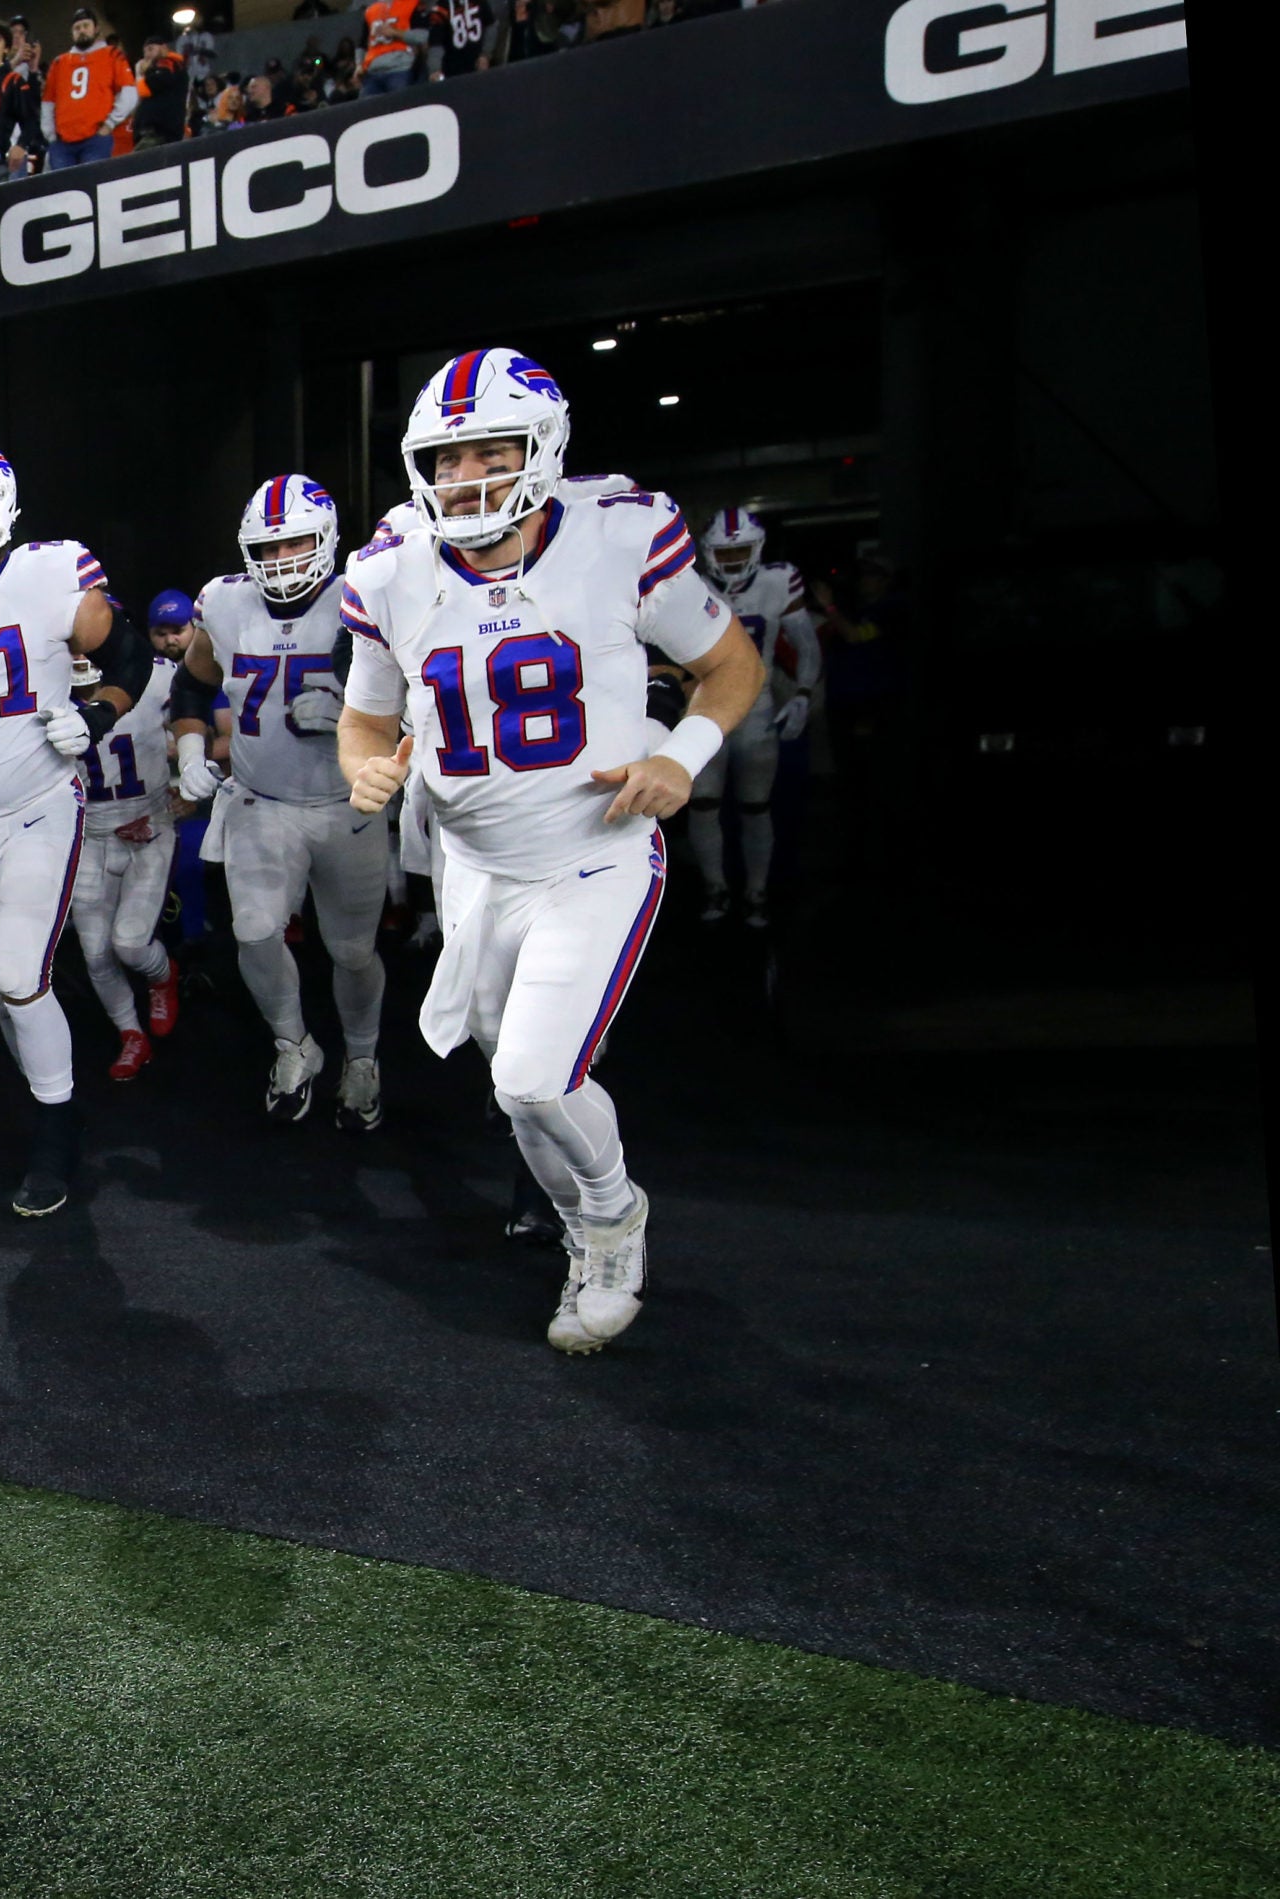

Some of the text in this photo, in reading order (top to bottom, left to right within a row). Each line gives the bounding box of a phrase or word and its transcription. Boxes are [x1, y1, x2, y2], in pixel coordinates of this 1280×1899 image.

[70, 66, 89, 100] 9
[478, 618, 521, 635] BILLS
[232, 653, 338, 738] 75
[421, 631, 587, 776] 18
[76, 733, 147, 802] 11
